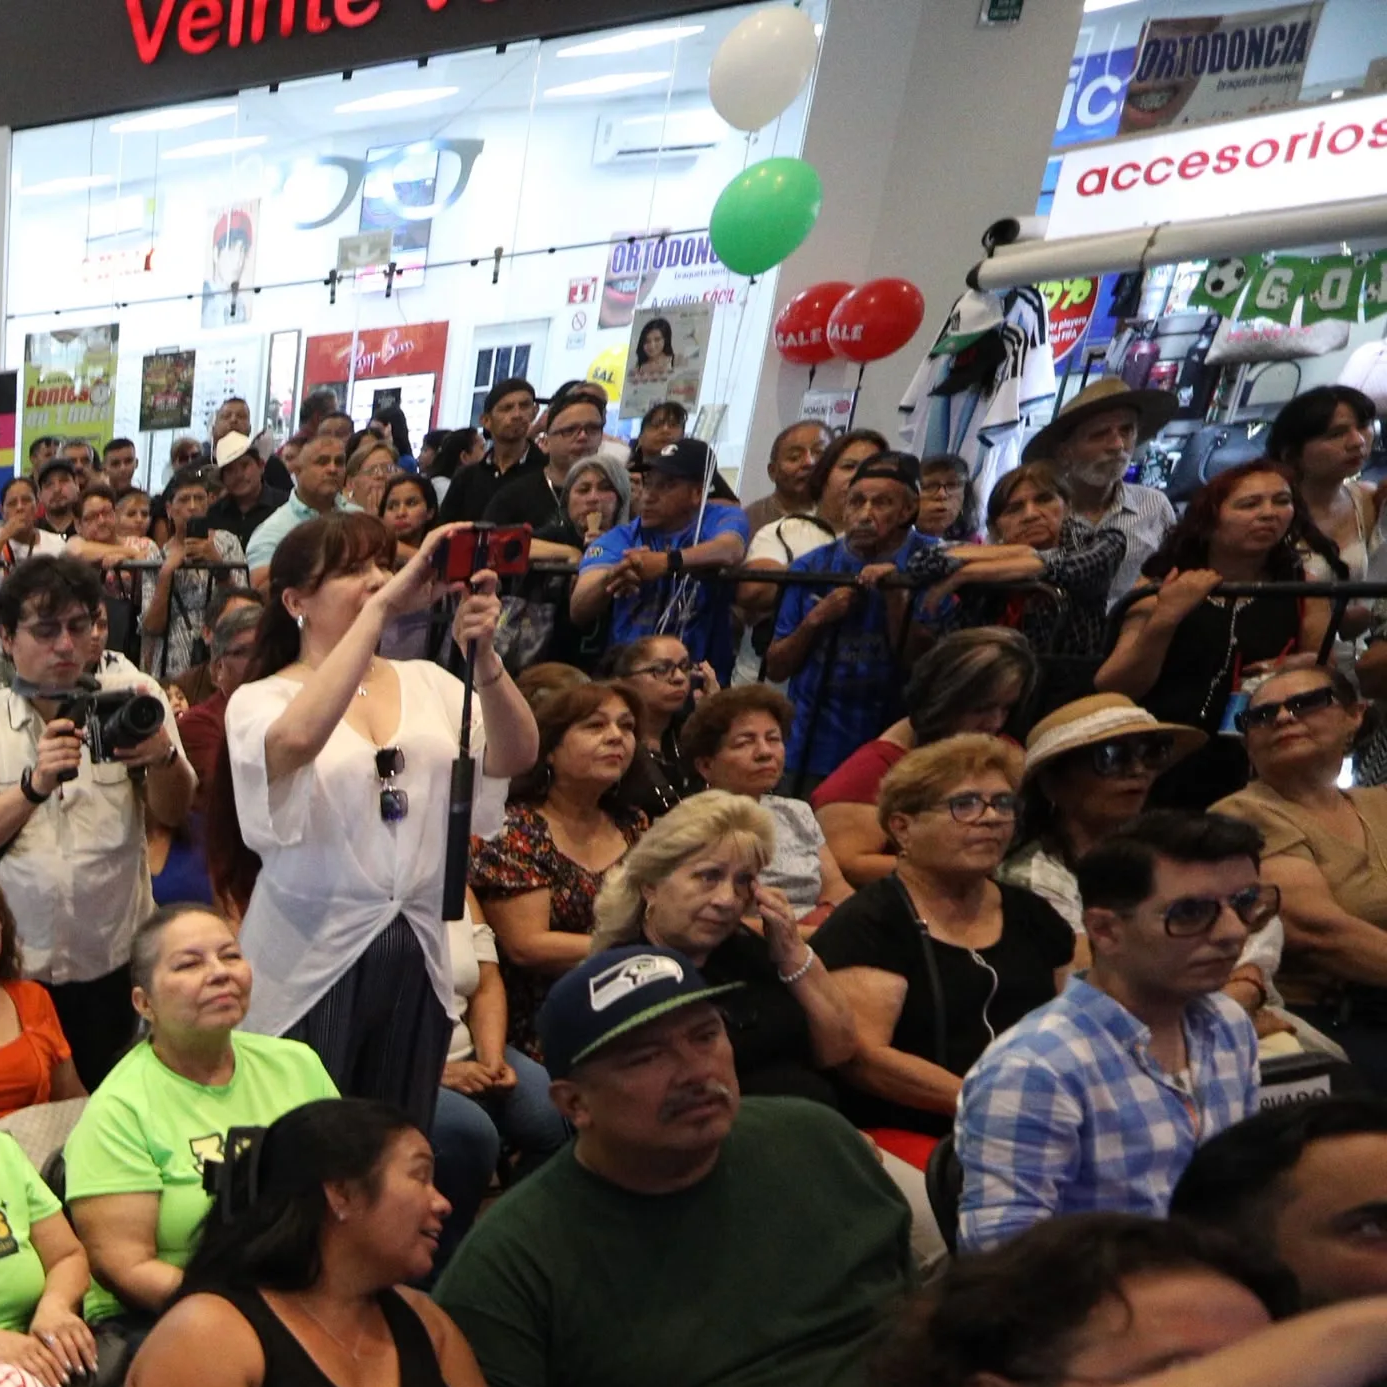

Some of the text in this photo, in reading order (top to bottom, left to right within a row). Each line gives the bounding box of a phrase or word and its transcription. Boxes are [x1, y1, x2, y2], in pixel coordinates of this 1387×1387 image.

[1136, 21, 1312, 82] ORTODONCIA
[1077, 118, 1387, 197] accesorios
[611, 236, 720, 274] ORTODON
[777, 327, 822, 348] SALE
